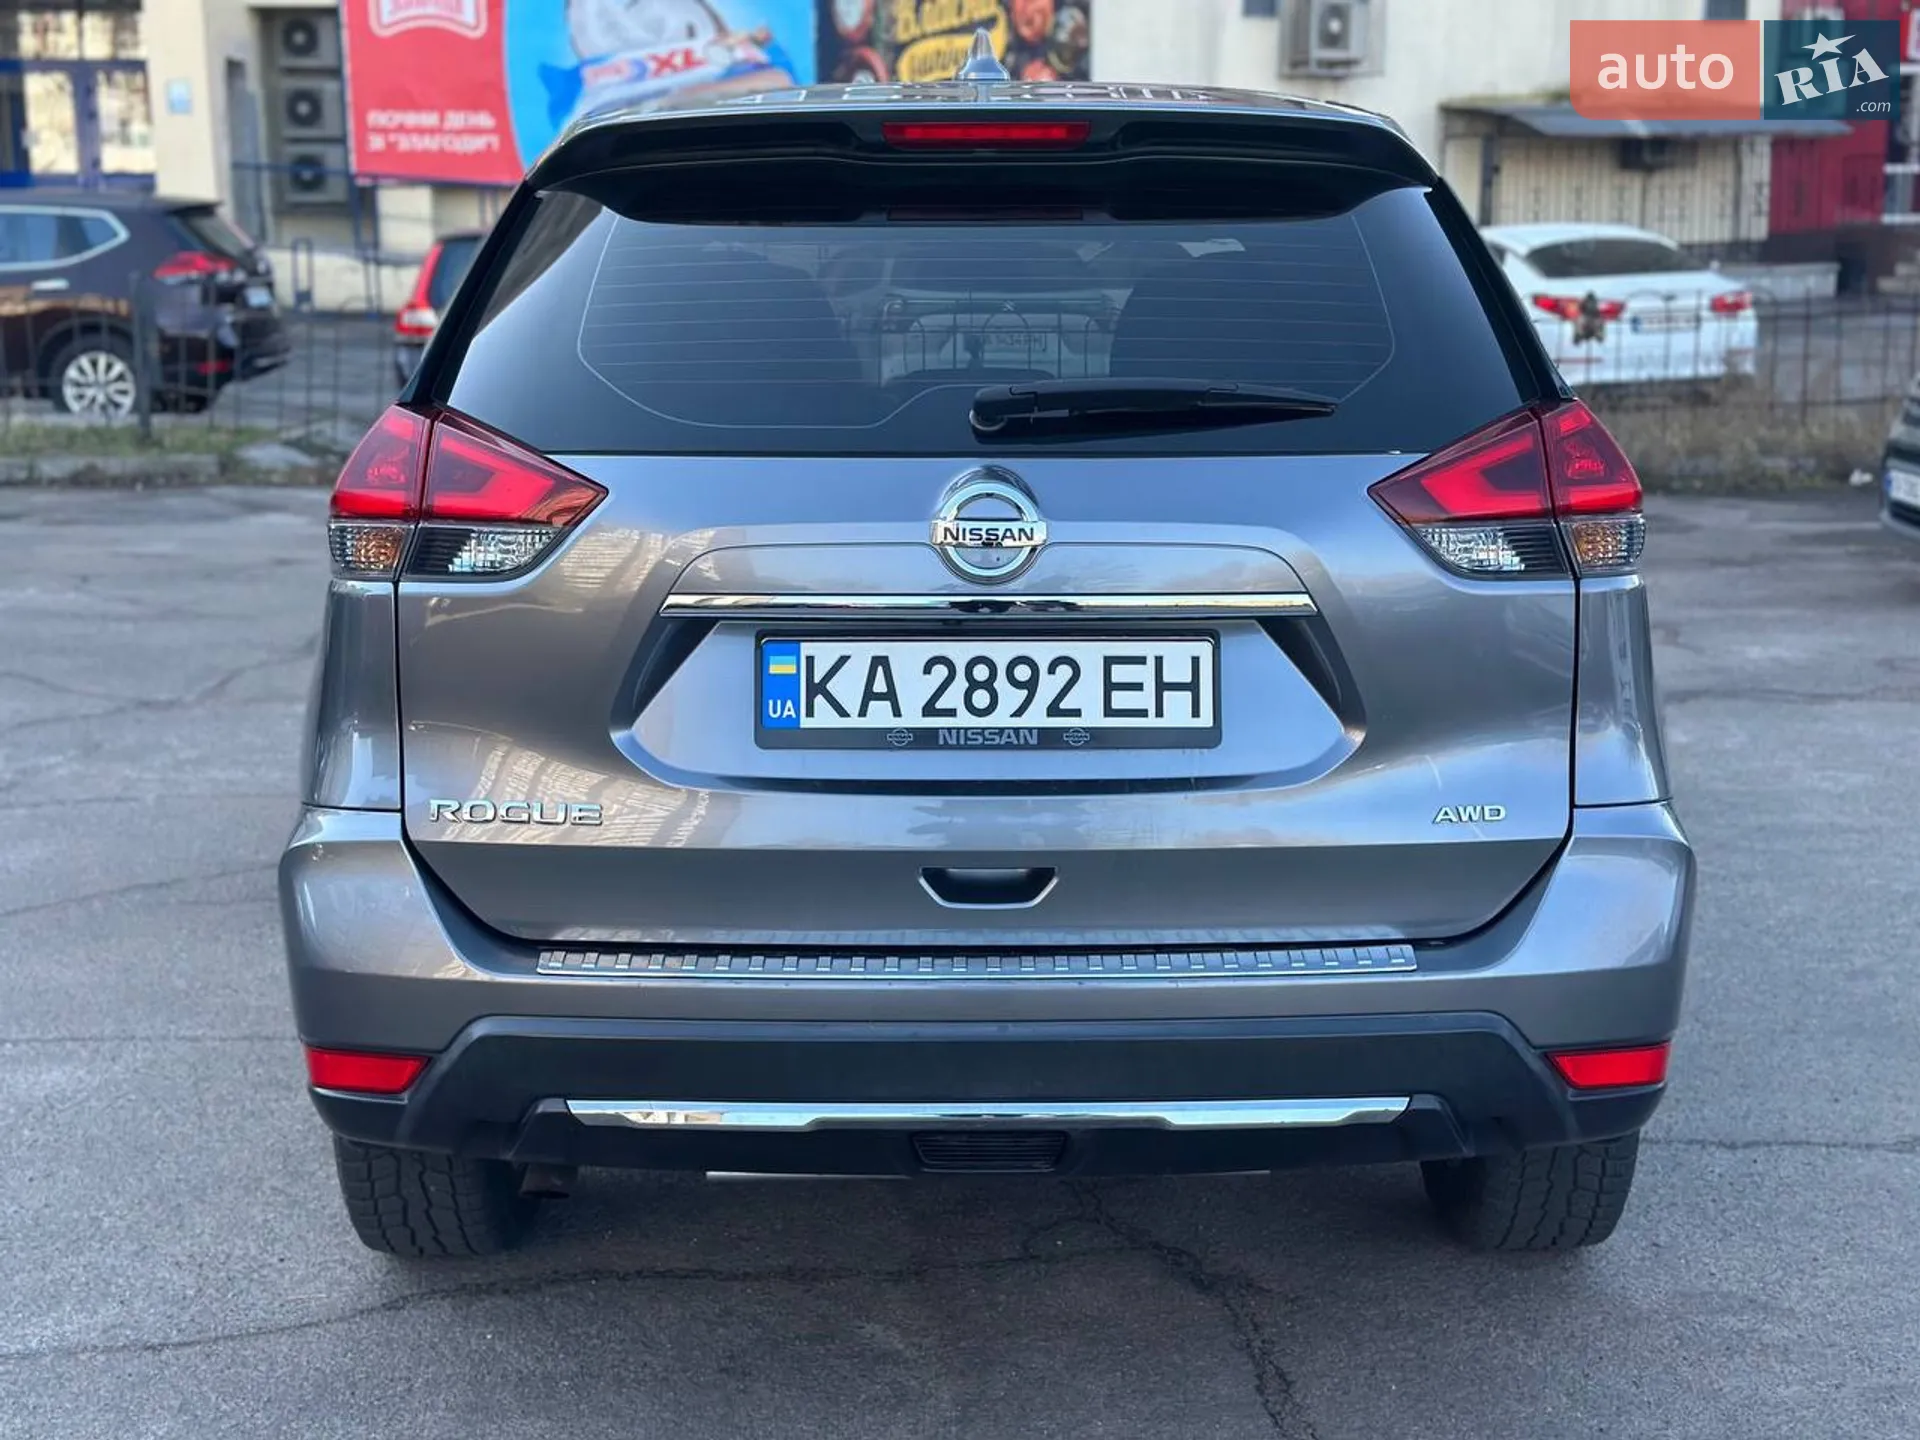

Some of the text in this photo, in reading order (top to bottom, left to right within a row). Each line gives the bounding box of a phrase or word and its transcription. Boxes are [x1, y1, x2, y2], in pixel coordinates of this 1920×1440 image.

[646, 47, 708, 79] XL
[943, 526, 1034, 542] NISSAN
[804, 655, 1201, 718] KA 2892 EH
[768, 699, 797, 719] UA
[938, 729, 1038, 745] NISSAN
[429, 799, 603, 826] ROGUE
[1432, 804, 1506, 824] AWD
